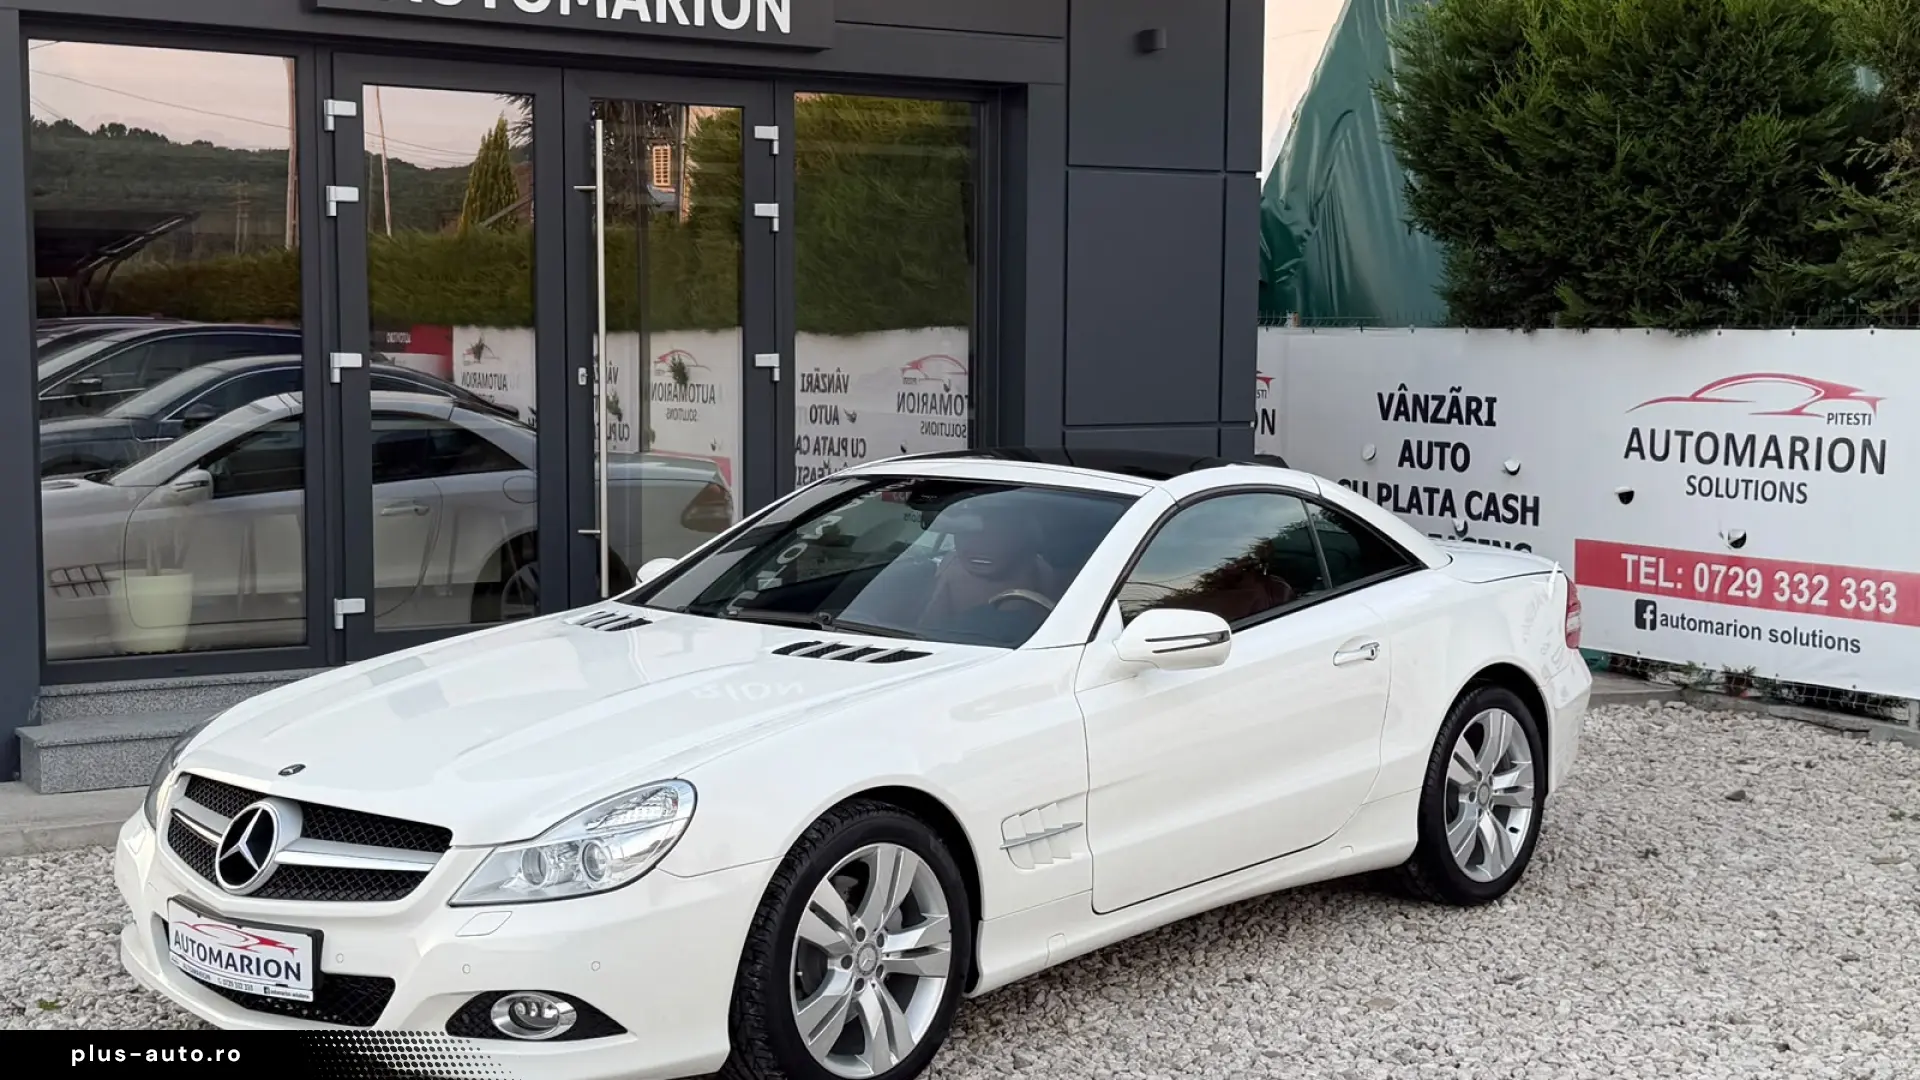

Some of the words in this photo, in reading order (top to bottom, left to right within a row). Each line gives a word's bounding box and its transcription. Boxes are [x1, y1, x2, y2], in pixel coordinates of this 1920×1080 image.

[1826, 412, 1872, 426] PITESTI
[1398, 439, 1471, 473] AUTO
[1623, 427, 1887, 475] AUTOMARION
[1376, 482, 1457, 519] PLATA
[1464, 490, 1540, 527] CASH
[1685, 474, 1809, 505] SOLUTIONS
[1621, 552, 1684, 590] TEL:
[1693, 562, 1763, 600] 0729
[1773, 570, 1829, 607] 332
[1839, 577, 1898, 614] 333
[1660, 609, 1762, 642] automarion
[1768, 625, 1862, 654] solutions
[174, 929, 302, 982] AUTOMARION
